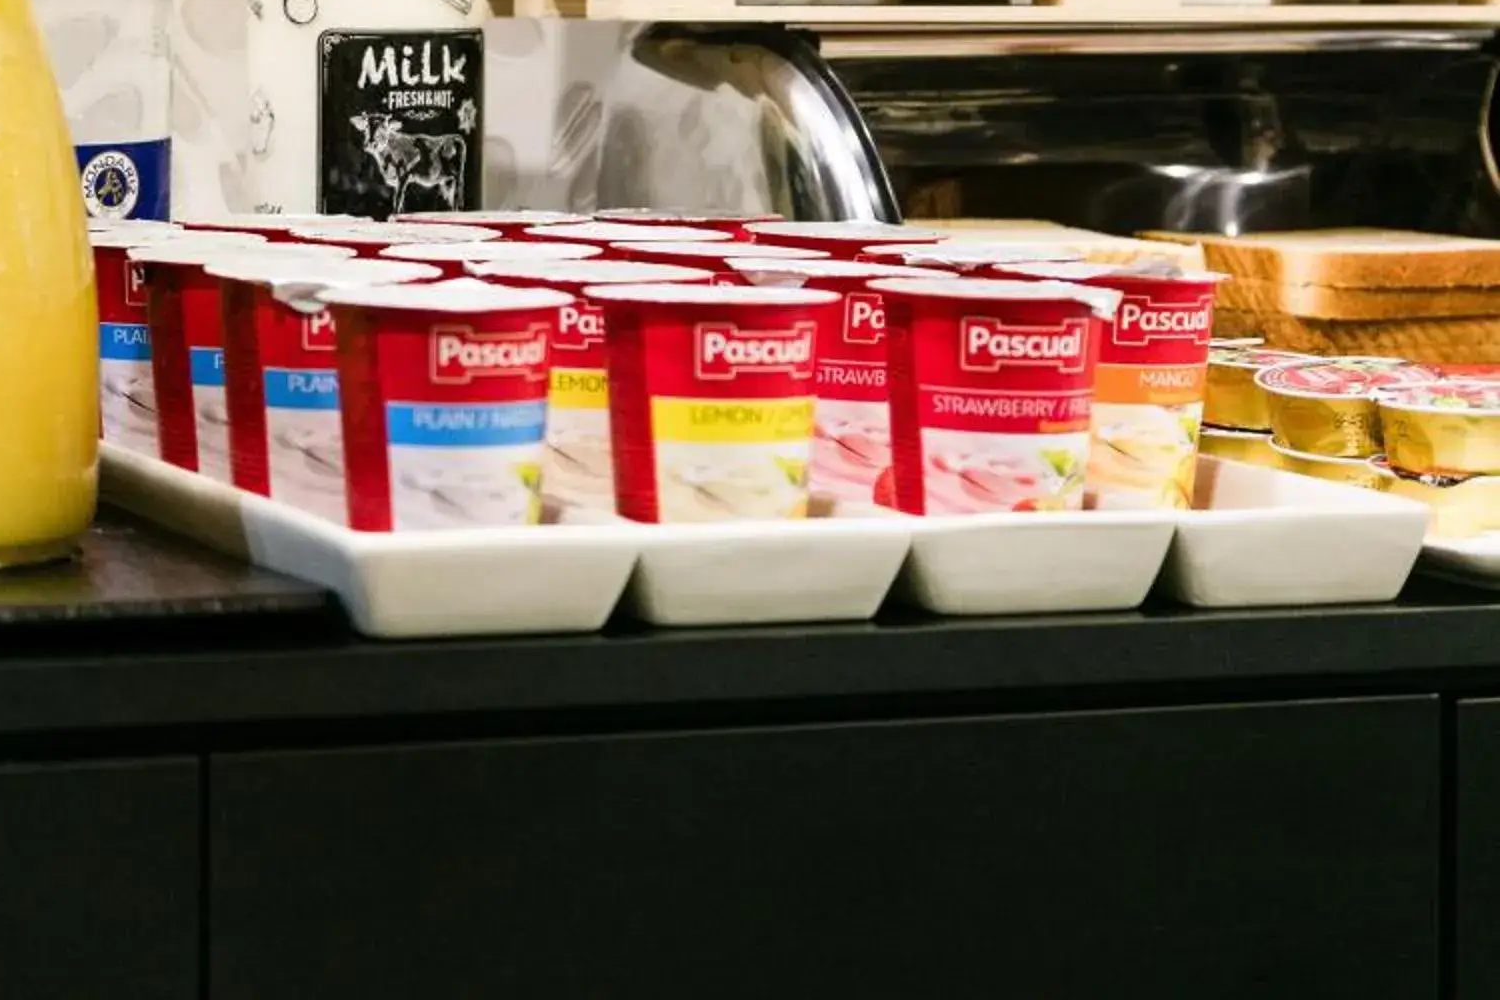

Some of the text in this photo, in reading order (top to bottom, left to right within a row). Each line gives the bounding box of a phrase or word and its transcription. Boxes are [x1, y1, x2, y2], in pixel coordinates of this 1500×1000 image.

[1121, 301, 1211, 332] Pascual
[113, 328, 147, 344] PLAI
[438, 333, 547, 368] Pascual
[703, 330, 813, 364] Pascual
[968, 325, 1081, 358] Pascual
[932, 393, 1054, 418] STRAWBERRY
